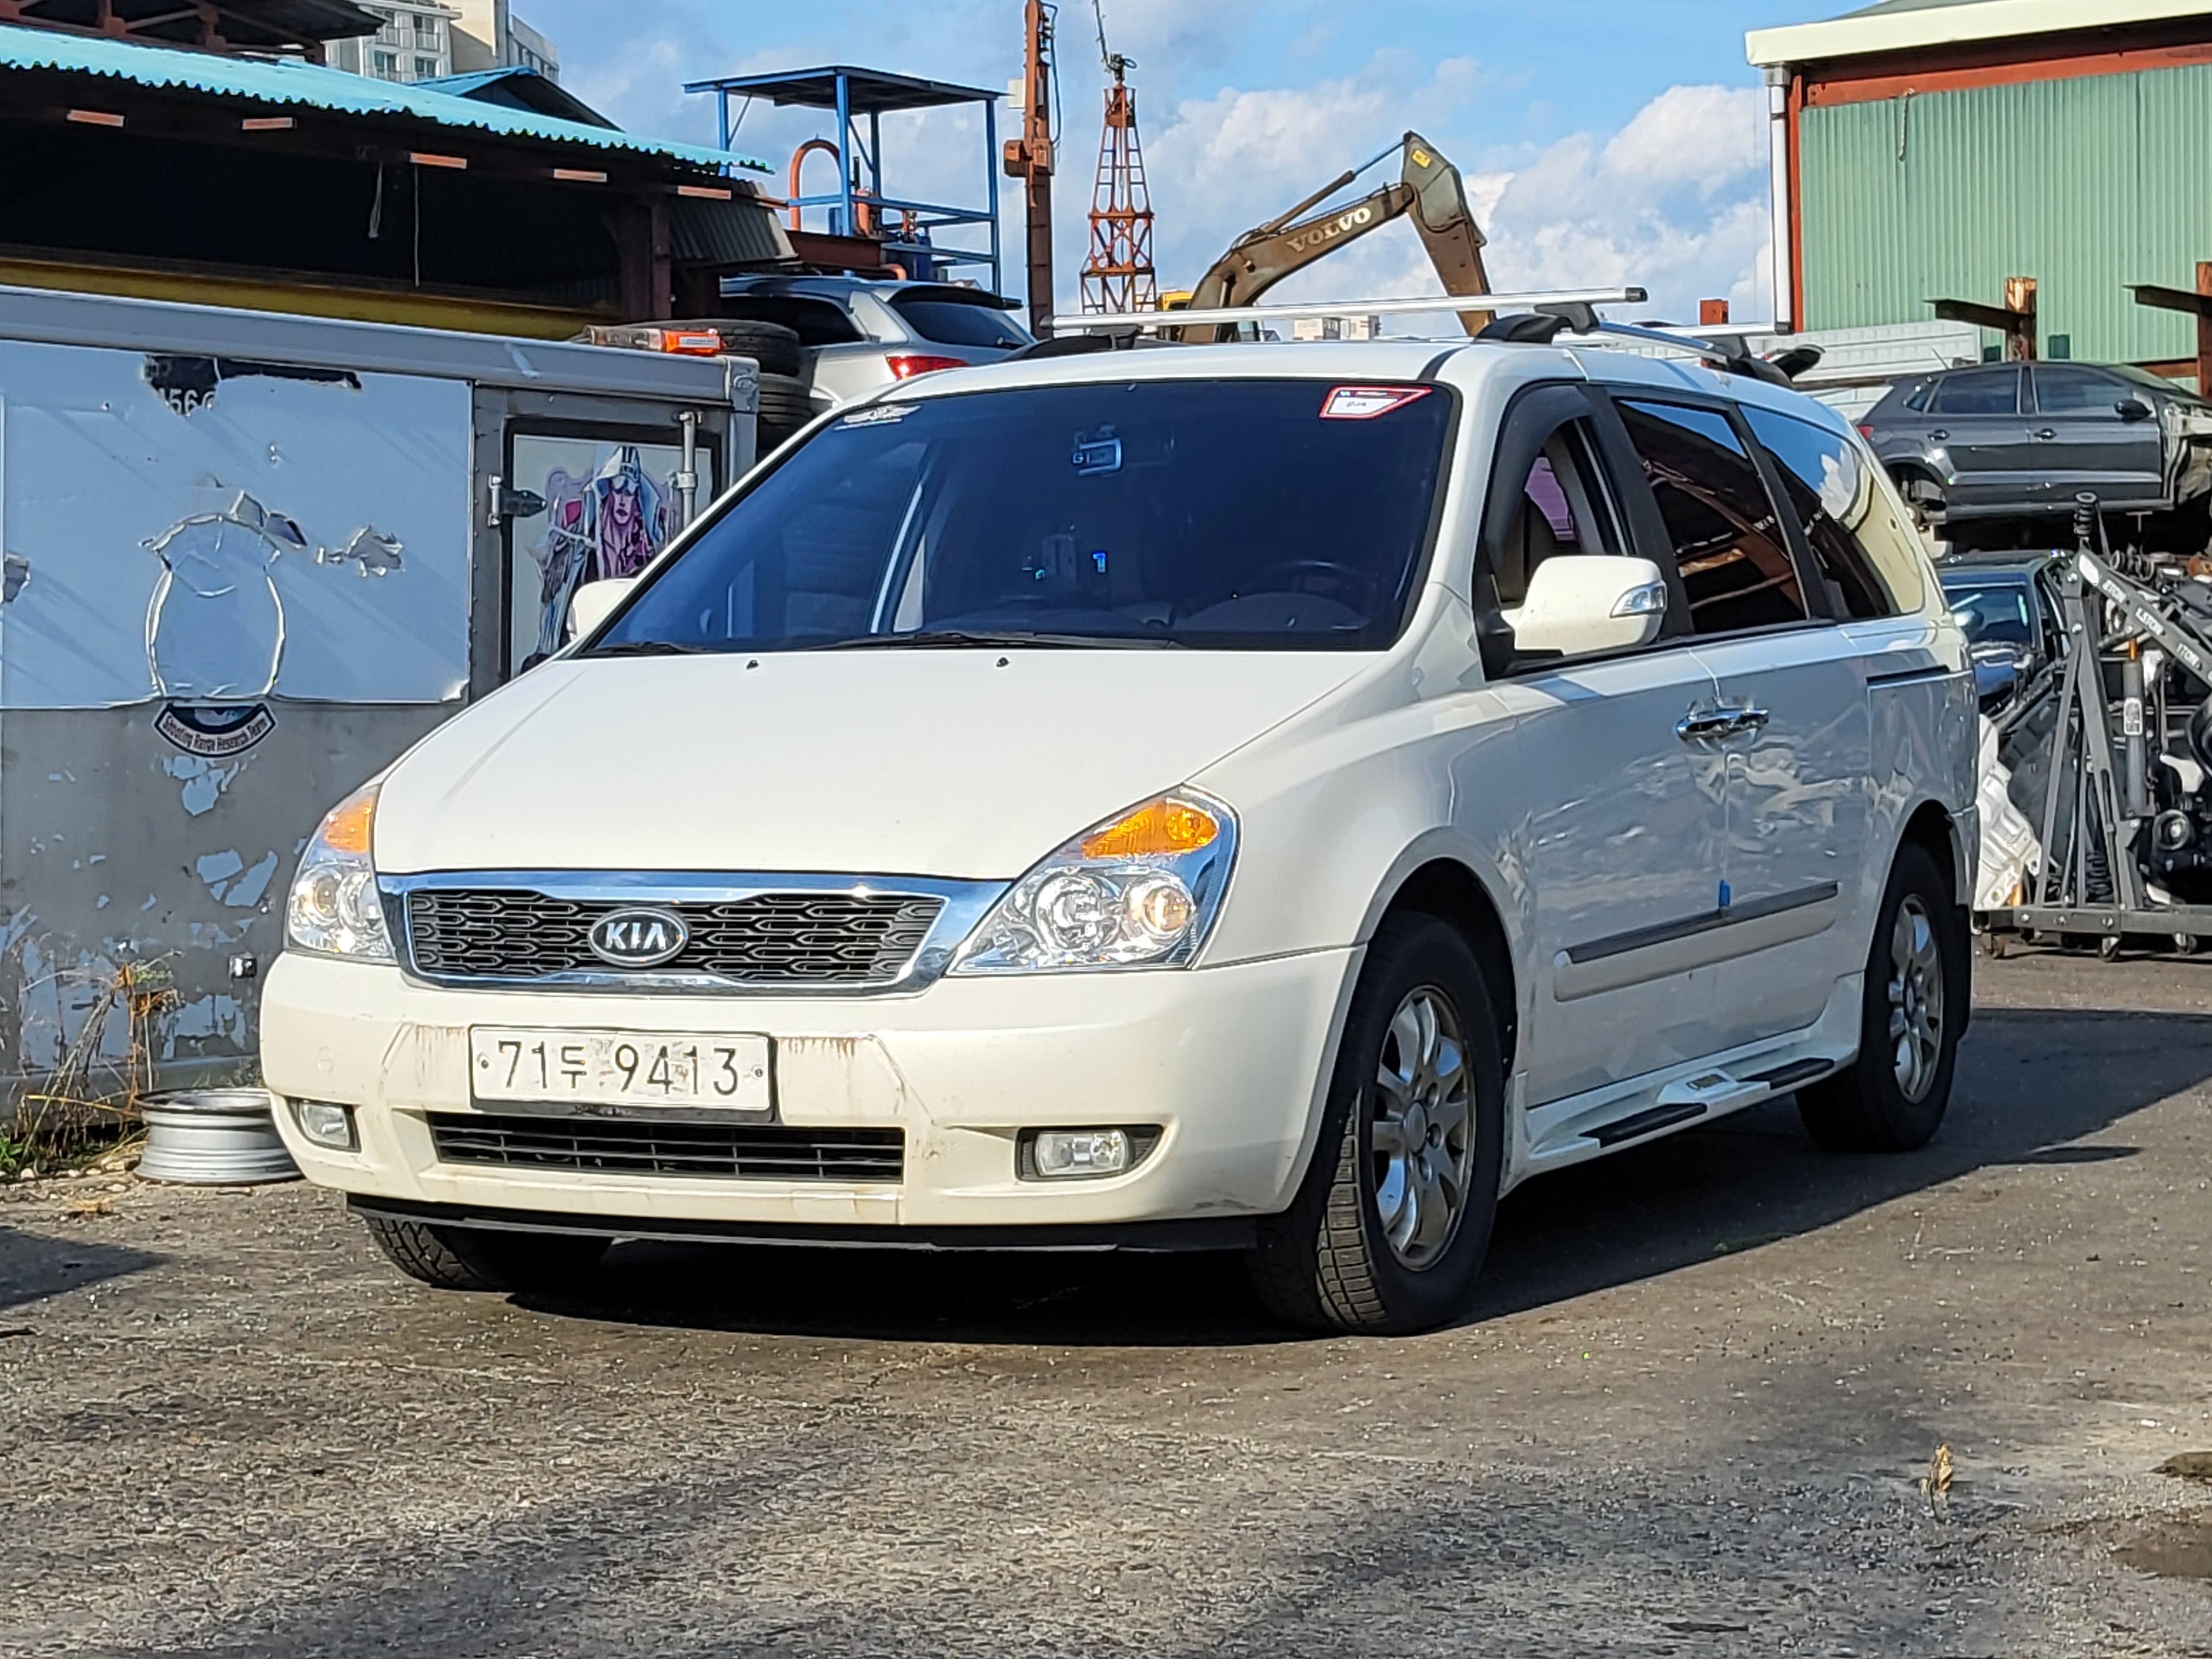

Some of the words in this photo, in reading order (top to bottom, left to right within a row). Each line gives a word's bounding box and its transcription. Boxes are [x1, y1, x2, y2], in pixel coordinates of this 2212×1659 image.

[1287, 207, 1371, 253] VOLVO
[605, 922, 666, 950] KIA
[498, 1039, 587, 1089] 71두
[615, 1044, 739, 1096] 9413
